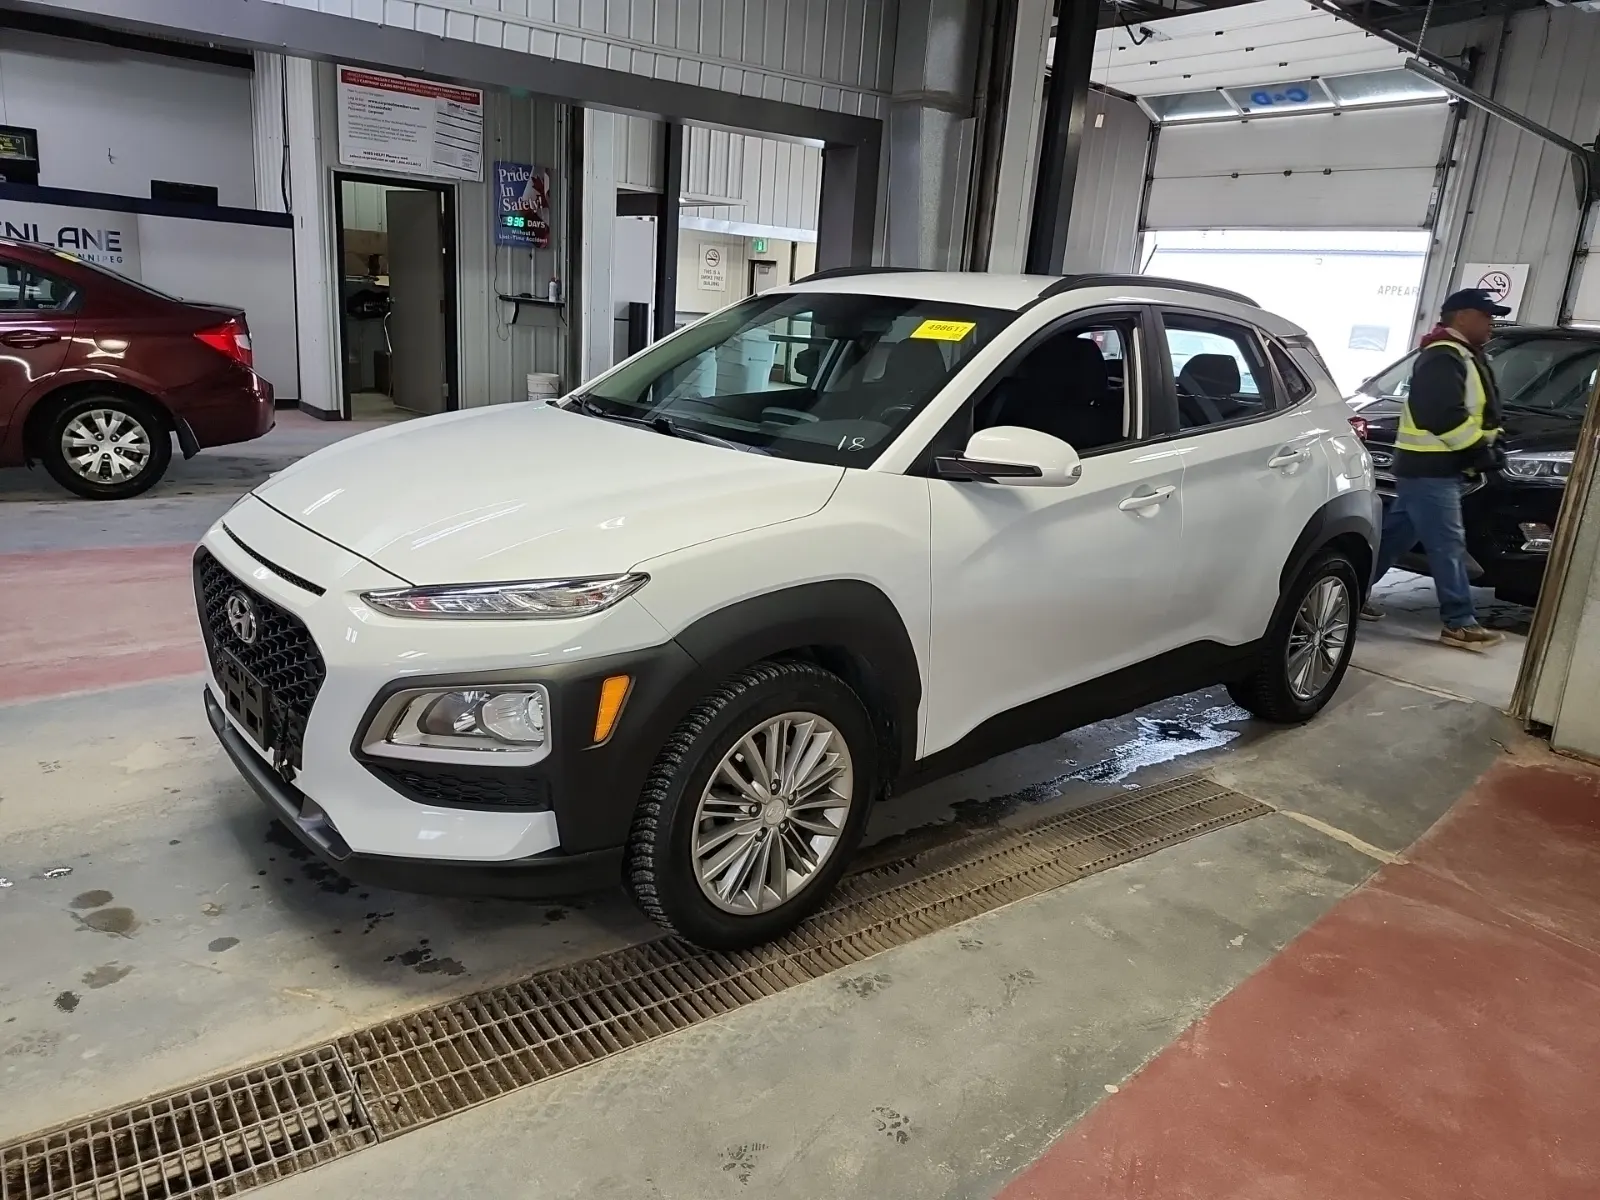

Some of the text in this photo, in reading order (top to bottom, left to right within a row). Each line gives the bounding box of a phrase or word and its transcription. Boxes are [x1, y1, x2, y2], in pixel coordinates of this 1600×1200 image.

[499, 167, 530, 183] Pride
[500, 184, 514, 197] In
[502, 197, 542, 213] Safety!
[527, 220, 545, 228] DAYS
[0, 221, 122, 252] NLANE
[837, 435, 865, 451] 18
